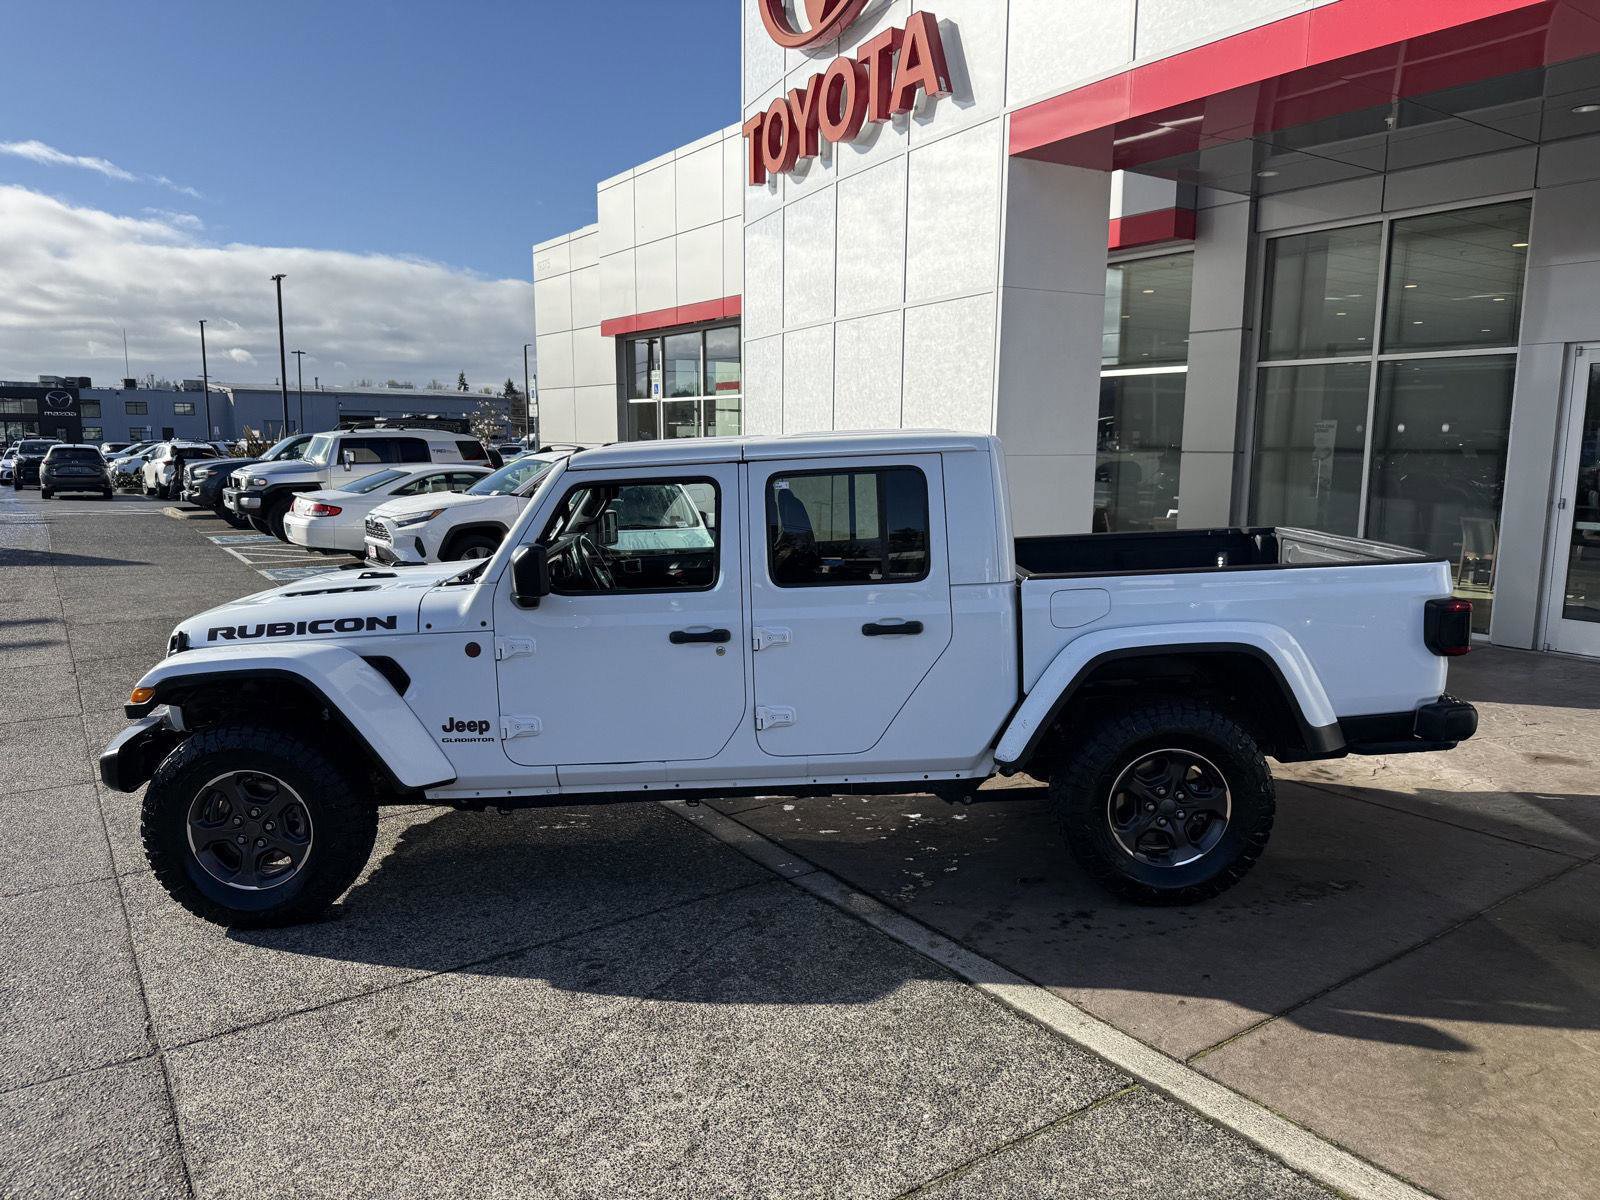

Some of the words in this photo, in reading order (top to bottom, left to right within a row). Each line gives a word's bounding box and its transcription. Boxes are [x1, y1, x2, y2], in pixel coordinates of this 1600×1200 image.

[742, 10, 953, 186] TOYOTA
[207, 615, 397, 641] RUBICON
[441, 716, 490, 735] Jeep
